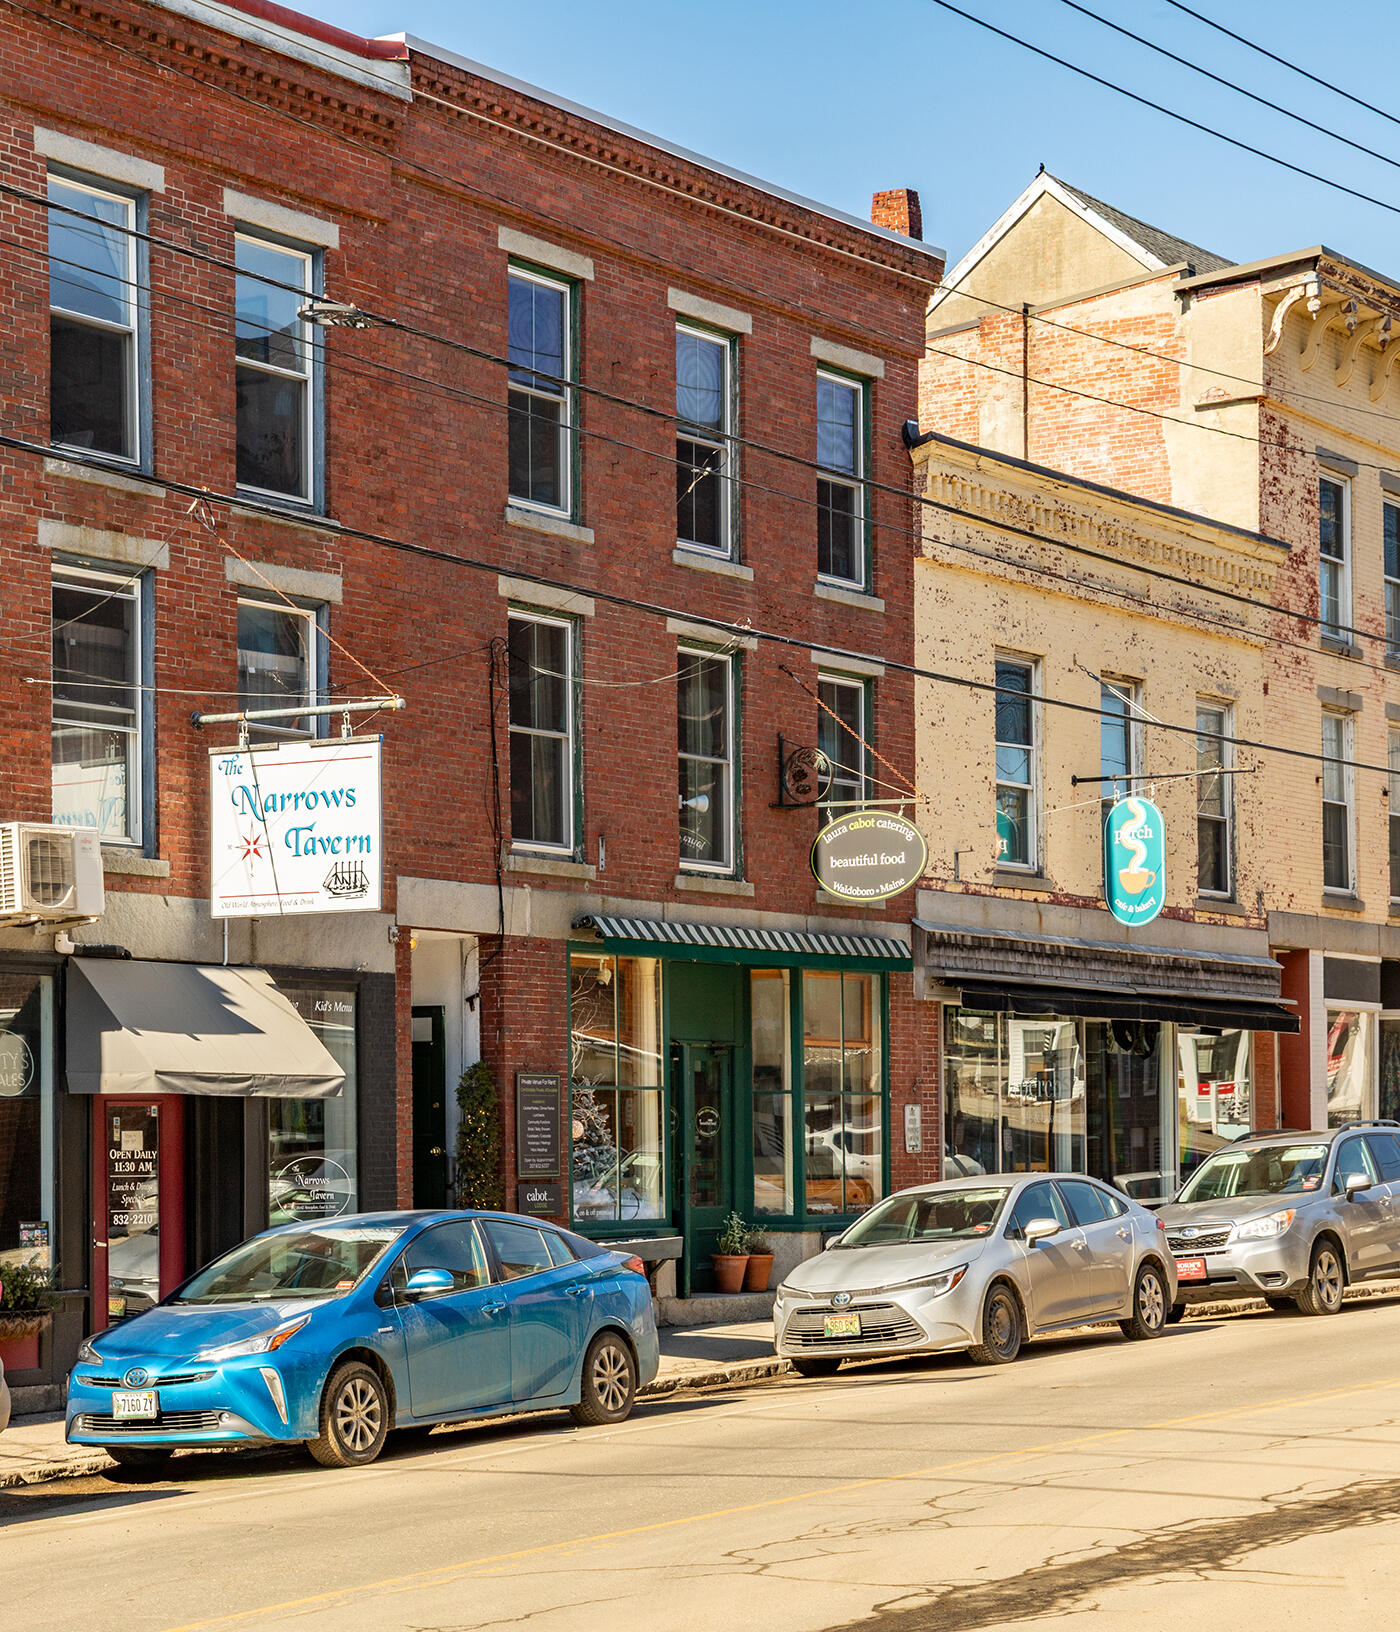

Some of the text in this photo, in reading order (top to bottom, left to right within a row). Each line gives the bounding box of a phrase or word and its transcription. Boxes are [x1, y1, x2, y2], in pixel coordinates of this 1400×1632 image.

[218, 753, 244, 776] The
[231, 784, 357, 822] Narrows
[823, 818, 916, 844] laura cabot catering
[1114, 824, 1154, 845] prch
[284, 820, 373, 858] Tavern
[830, 852, 906, 869] beautiful food
[832, 877, 906, 897] Waldoboro Maine
[1114, 897, 1128, 912] cafe
[1134, 896, 1157, 913] bakery
[314, 1000, 353, 1013] Kid's Menu
[109, 1148, 158, 1160] OPEN DAILY
[114, 1161, 153, 1173] 11:30 AM
[111, 1182, 130, 1192] Lunch
[130, 1182, 136, 1192] &
[295, 1174, 330, 1189] Narrows
[309, 1189, 335, 1201] Tavern
[526, 1187, 548, 1202] cabot
[112, 1213, 153, 1226] 832-2210
[121, 1397, 153, 1412] 7160 ZY
